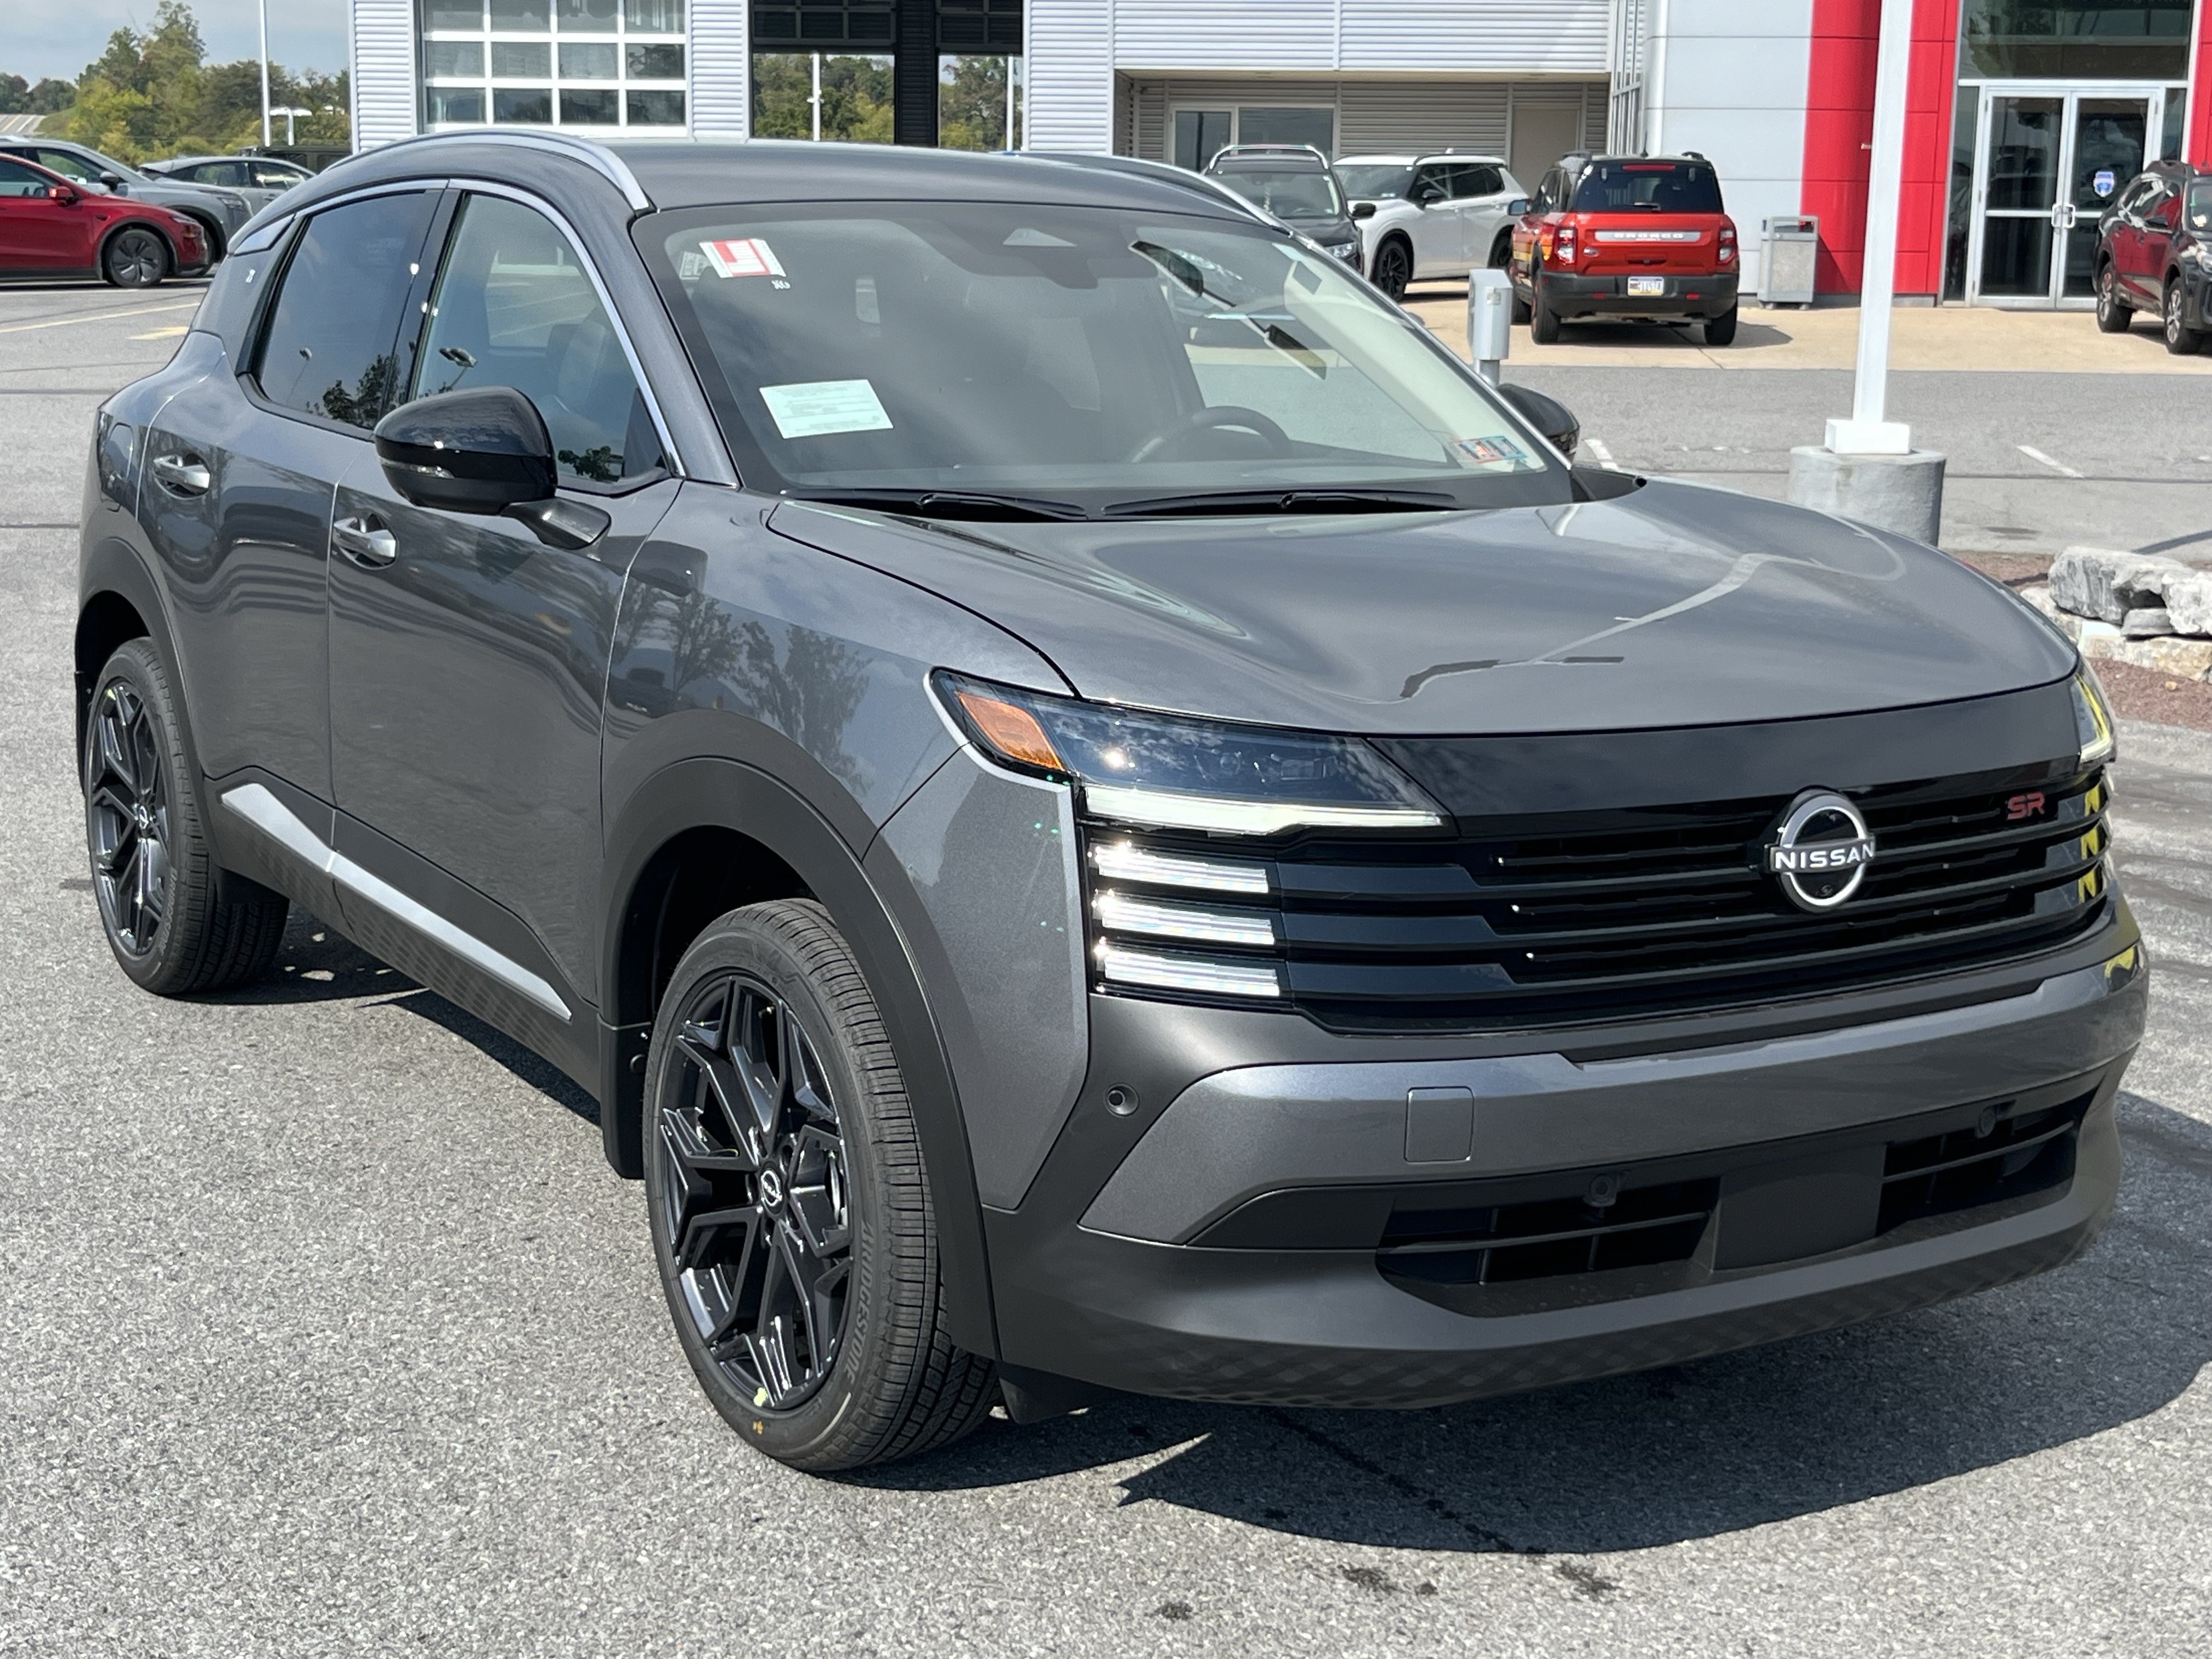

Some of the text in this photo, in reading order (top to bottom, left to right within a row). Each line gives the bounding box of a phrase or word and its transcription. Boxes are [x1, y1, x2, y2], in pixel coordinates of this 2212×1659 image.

[2007, 792, 2045, 819] SR
[1775, 841, 1875, 869] NISSAN
[844, 1220, 874, 1384] BRIDGESTONE
